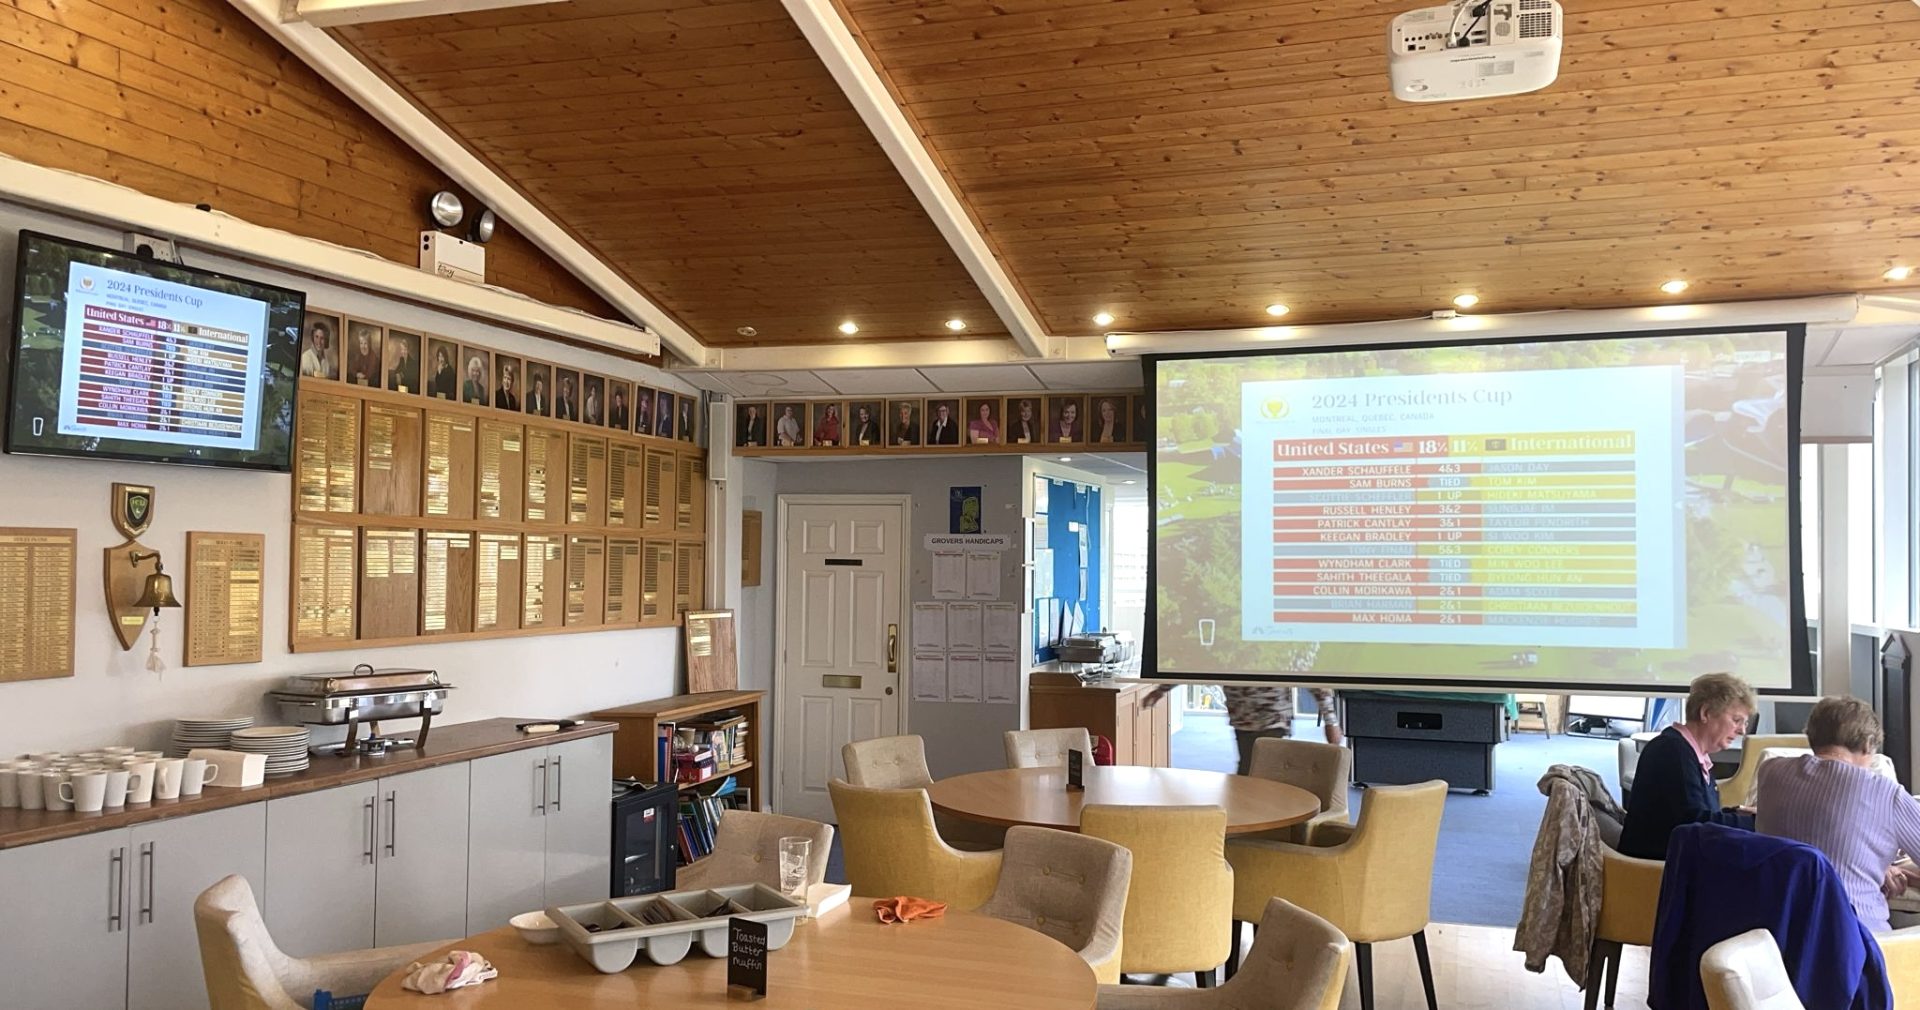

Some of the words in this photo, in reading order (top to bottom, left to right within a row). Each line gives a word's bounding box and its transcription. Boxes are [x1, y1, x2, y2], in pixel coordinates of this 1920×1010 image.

[106, 279, 132, 293] 2024
[134, 284, 183, 304] Presidents
[185, 296, 204, 309] Cup
[86, 307, 118, 321] United
[118, 313, 145, 326] States
[197, 326, 249, 344] International
[1311, 393, 1358, 409] 2024
[1365, 388, 1468, 408] Presidents
[1473, 387, 1513, 407] Cup
[1276, 440, 1335, 457] United
[1337, 440, 1390, 456] States
[1510, 433, 1633, 452] International
[1302, 467, 1344, 477] XANDER
[1348, 465, 1412, 476] SCHAUFFELE
[1438, 464, 1461, 474] 4&3
[1527, 462, 1550, 472] DAY
[1349, 479, 1372, 489] SAM
[1376, 479, 1413, 489] BURNS
[1439, 477, 1461, 487] TIED
[1488, 478, 1512, 487] TOM
[1446, 490, 1463, 500] UP
[1322, 505, 1367, 515] RUSSELL
[1371, 505, 1412, 515] HENLEY
[1439, 503, 1461, 513] 3&2
[1317, 519, 1361, 528] PATRICK
[1364, 518, 1412, 528] CANTLAY
[1439, 518, 1461, 528] 3&1
[931, 537, 964, 545] GROVERS
[965, 537, 1004, 545] HANDICAPS
[1320, 532, 1361, 541] KEEGAN
[1365, 531, 1412, 541] BRADLEY
[1446, 531, 1463, 541] UP
[1439, 544, 1461, 555] 5&3
[1318, 559, 1374, 568] WYNDHAM
[1378, 559, 1412, 568] CLARK
[1439, 559, 1462, 568] TIED
[1316, 572, 1355, 582] SAHITH
[1359, 572, 1412, 582] THEEGALA
[1439, 572, 1462, 582] TIED
[1312, 585, 1349, 596] COLLIN
[1354, 585, 1413, 596] MORIKAWA
[1439, 585, 1462, 595] 2&1
[1439, 600, 1462, 610] 2&1
[1352, 613, 1376, 622] MAX
[1379, 613, 1414, 622] HOMA
[1439, 613, 1462, 624] 2&1
[733, 927, 766, 946] Toasted
[731, 941, 763, 957] Butter
